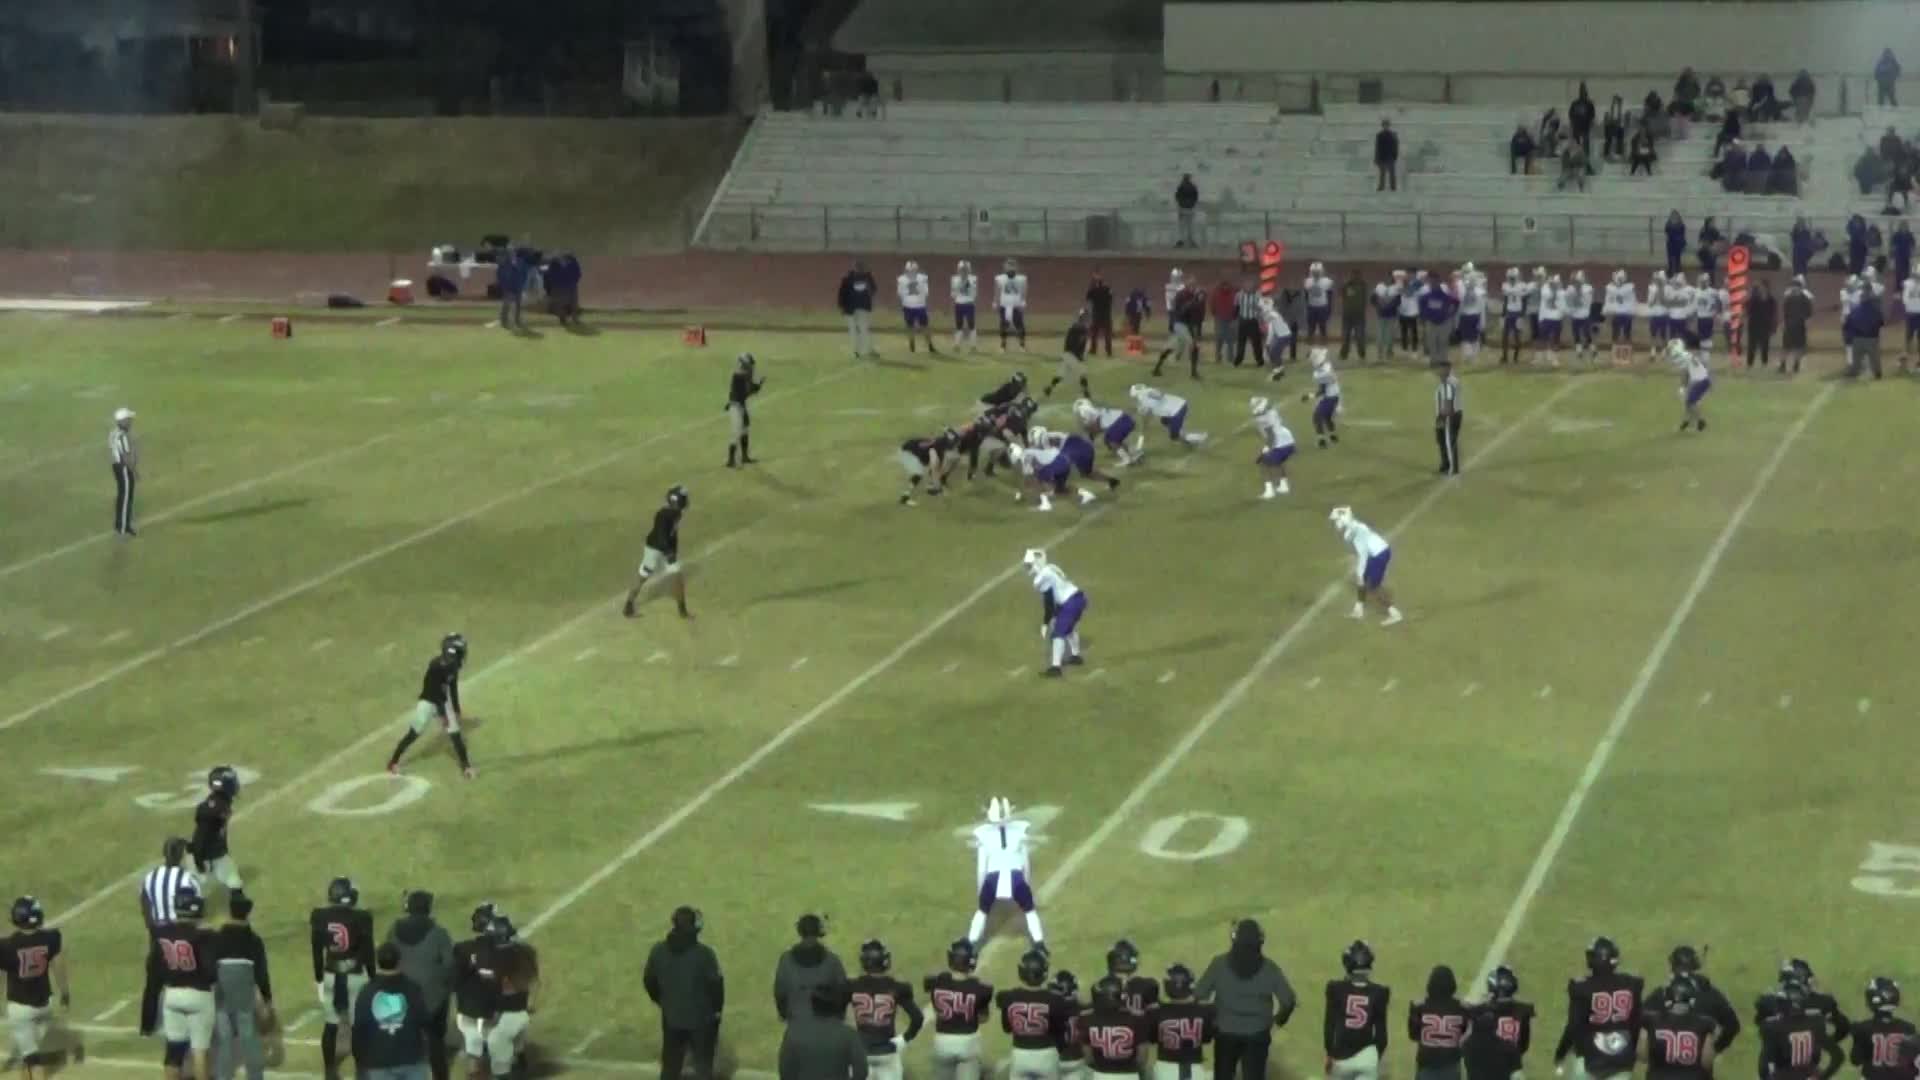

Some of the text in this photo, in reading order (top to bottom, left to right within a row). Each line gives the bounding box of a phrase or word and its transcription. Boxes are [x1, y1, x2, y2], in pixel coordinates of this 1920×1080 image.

[1000, 825, 1007, 850] 1
[328, 922, 349, 952] 3
[16, 945, 48, 978] 15
[852, 993, 896, 1025] 22
[934, 989, 976, 1022] 54
[1007, 1002, 1050, 1035] 65
[1345, 994, 1369, 1029] 5
[1589, 989, 1634, 1024] 99
[1089, 1026, 1134, 1058] 42
[1421, 1014, 1463, 1047] 25
[1655, 1029, 1698, 1065] 78
[1789, 1031, 1812, 1066] 11
